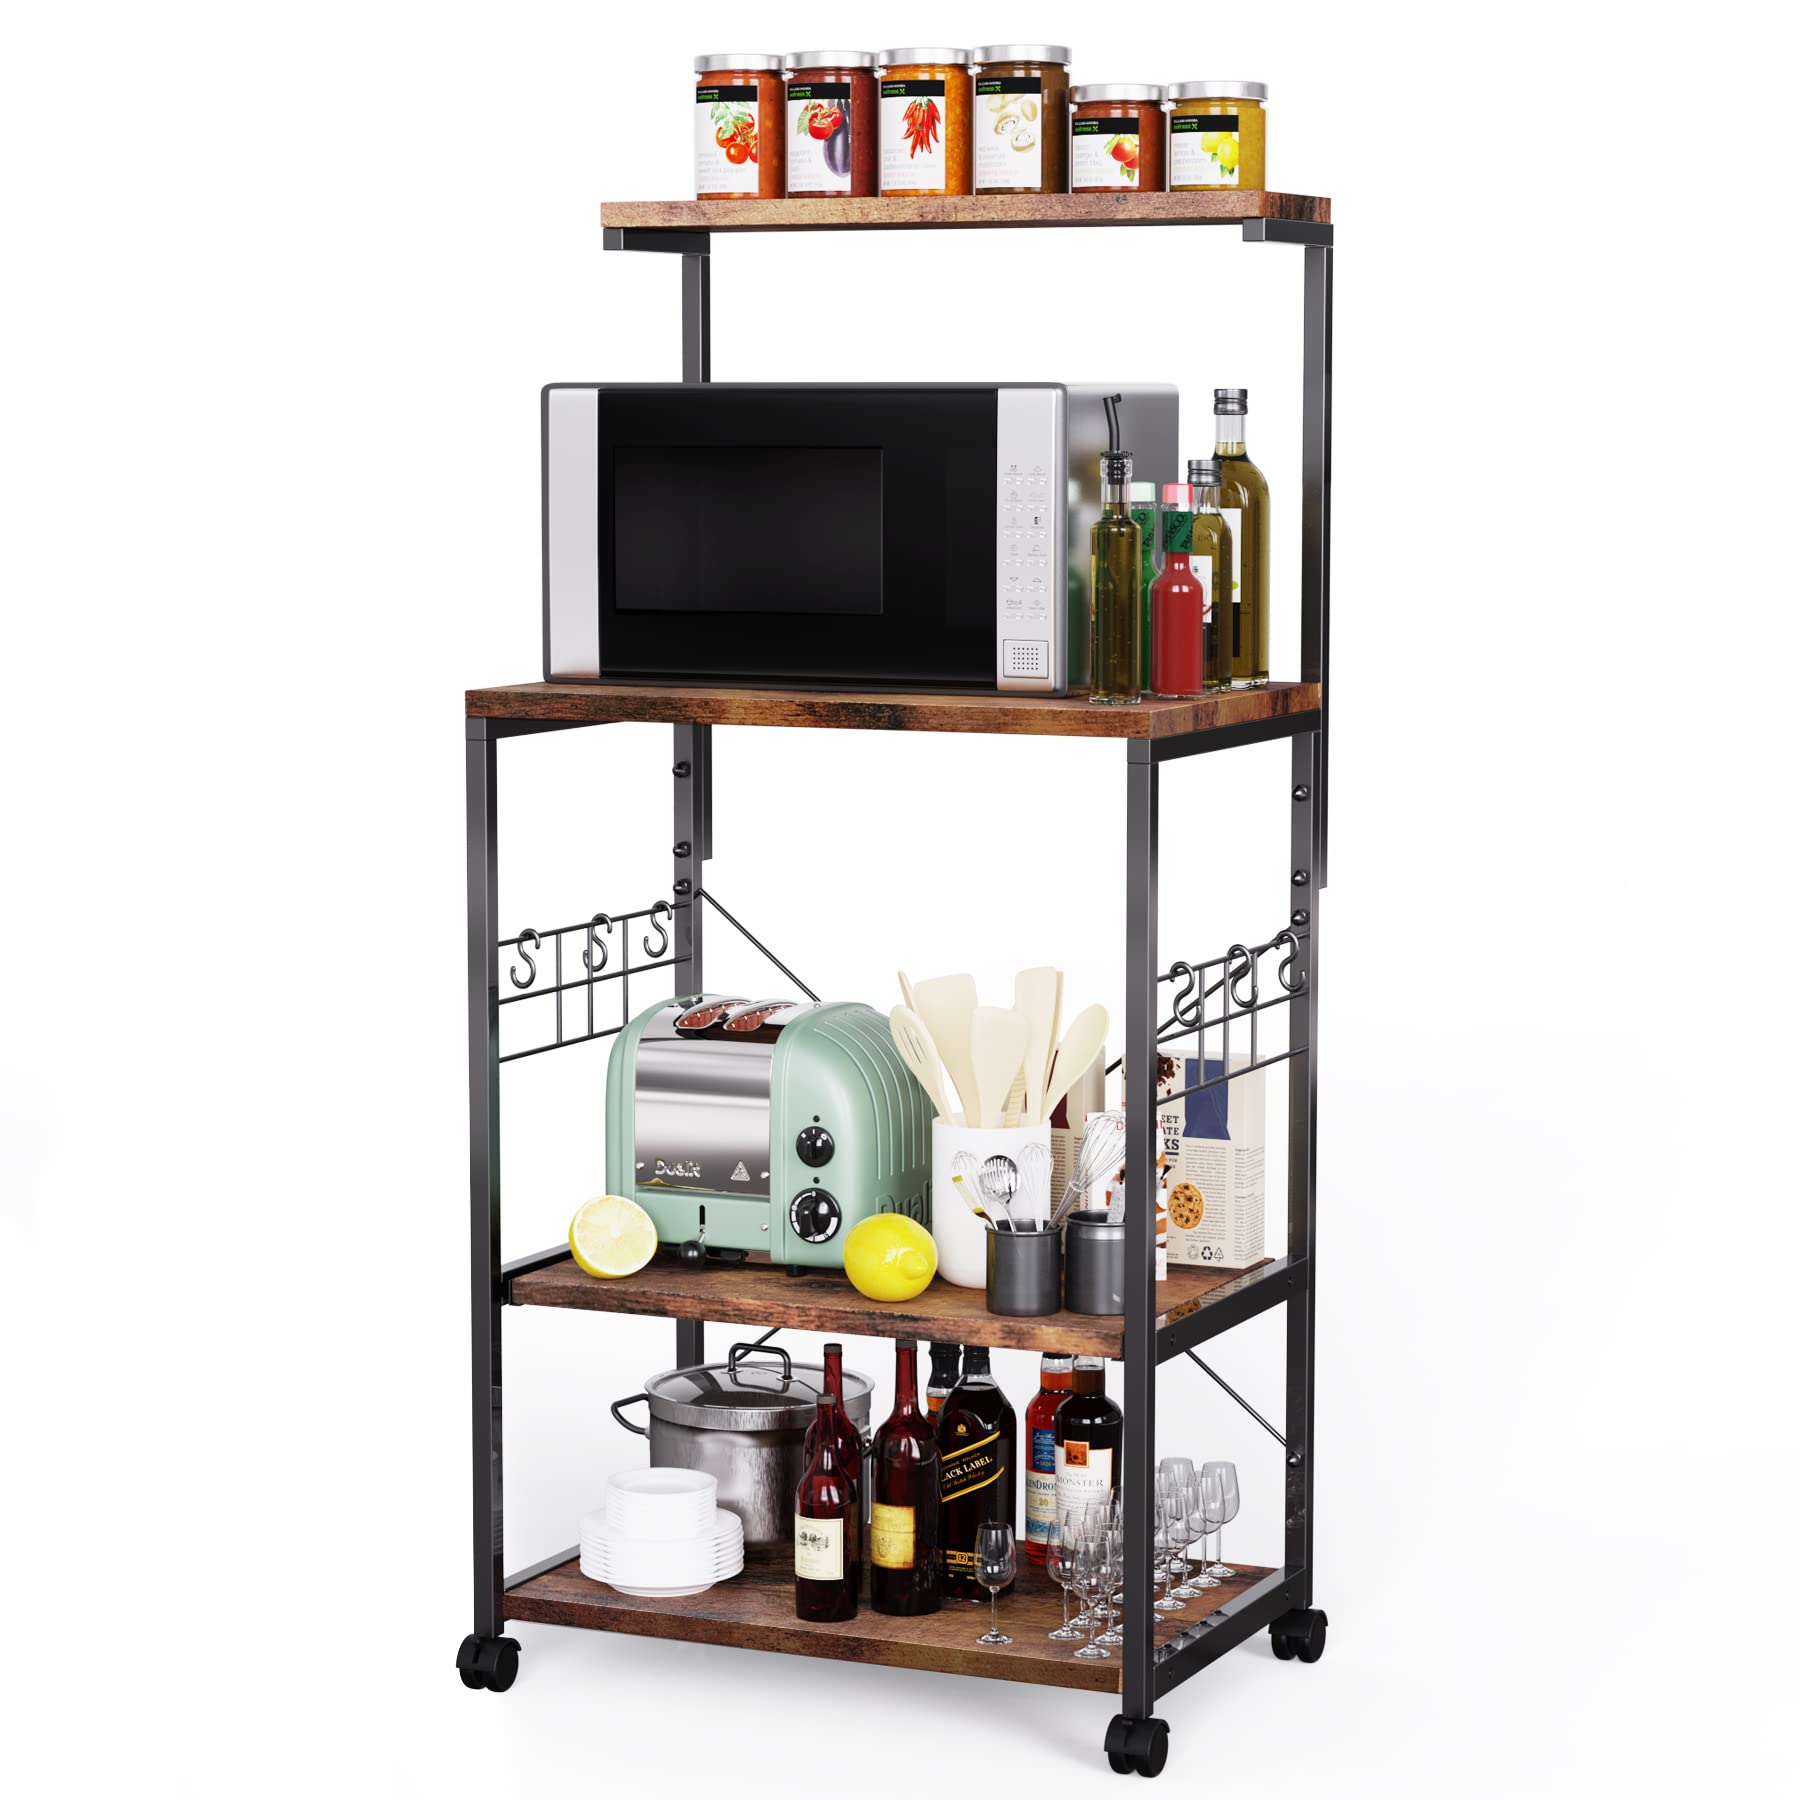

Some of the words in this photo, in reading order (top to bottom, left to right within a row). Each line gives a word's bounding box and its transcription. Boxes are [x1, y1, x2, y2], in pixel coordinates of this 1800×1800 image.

[654, 1159, 701, 1178] Dualit
[942, 1467, 964, 1483] ACK
[963, 1455, 993, 1474] LABEL
[1056, 1475, 1104, 1487] MONSTER
